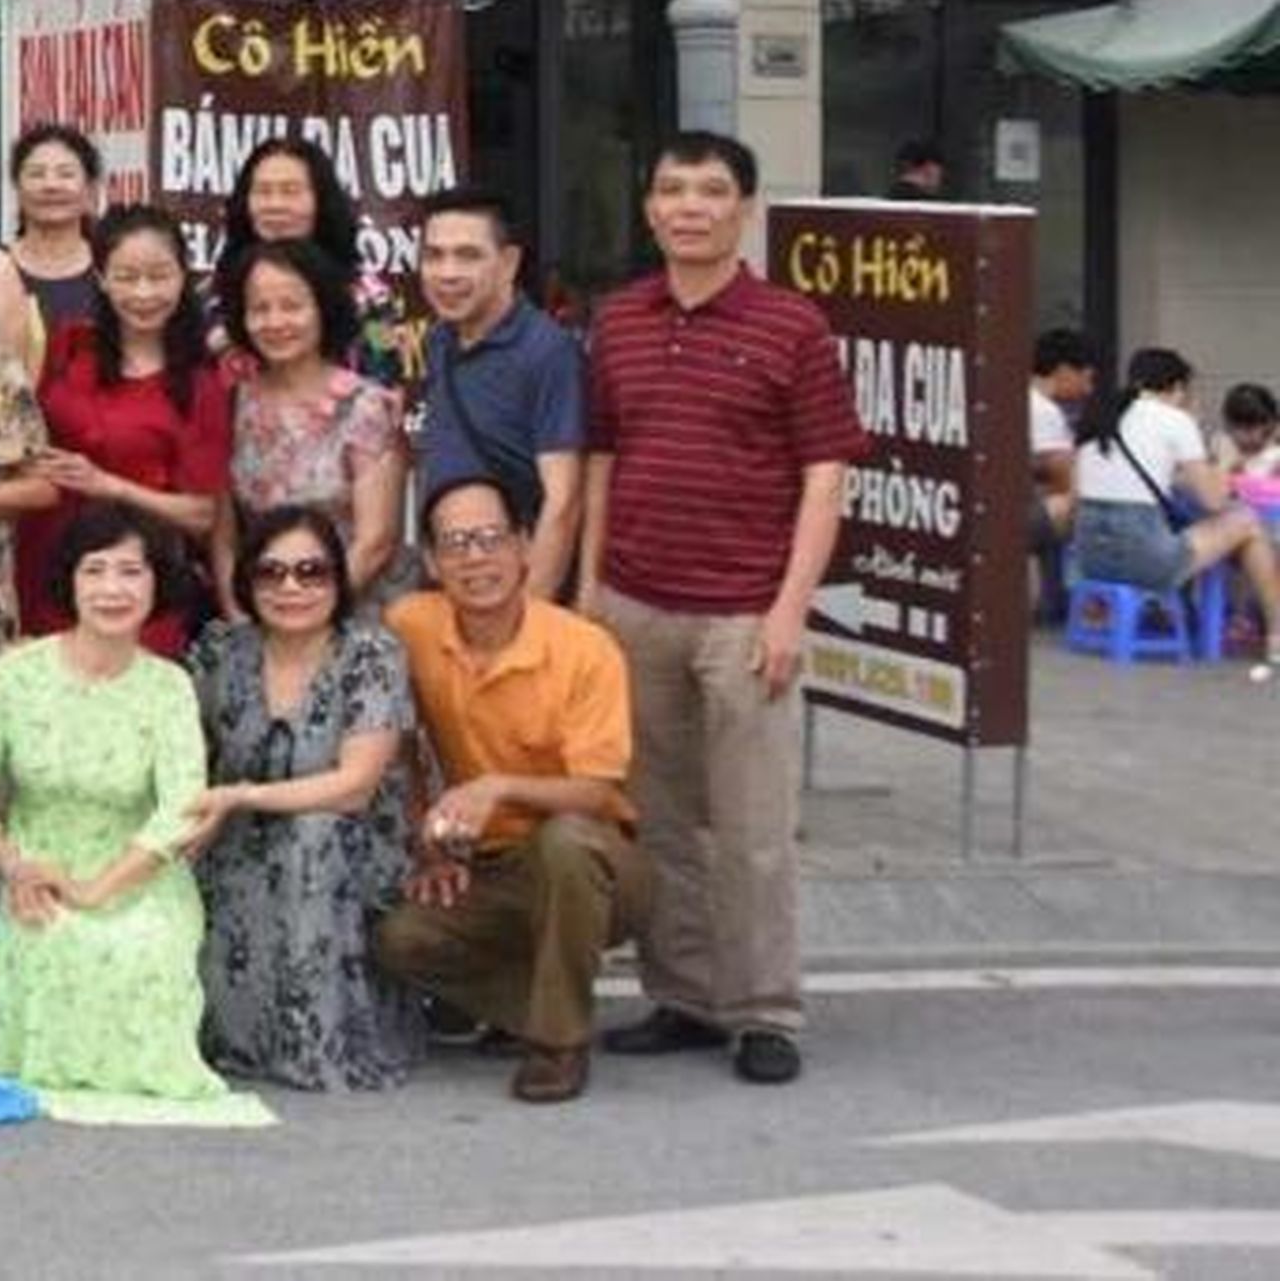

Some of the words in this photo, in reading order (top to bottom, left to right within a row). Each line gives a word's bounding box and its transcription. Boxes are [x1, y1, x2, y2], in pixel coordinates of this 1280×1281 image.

[192, 12, 272, 76] Cô
[293, 17, 426, 79] Hiền
[370, 114, 457, 199] CUA
[790, 231, 839, 294] Cô
[853, 231, 950, 301] Hiền
[904, 341, 968, 447] CUA
[842, 458, 961, 538] PHÒNG
